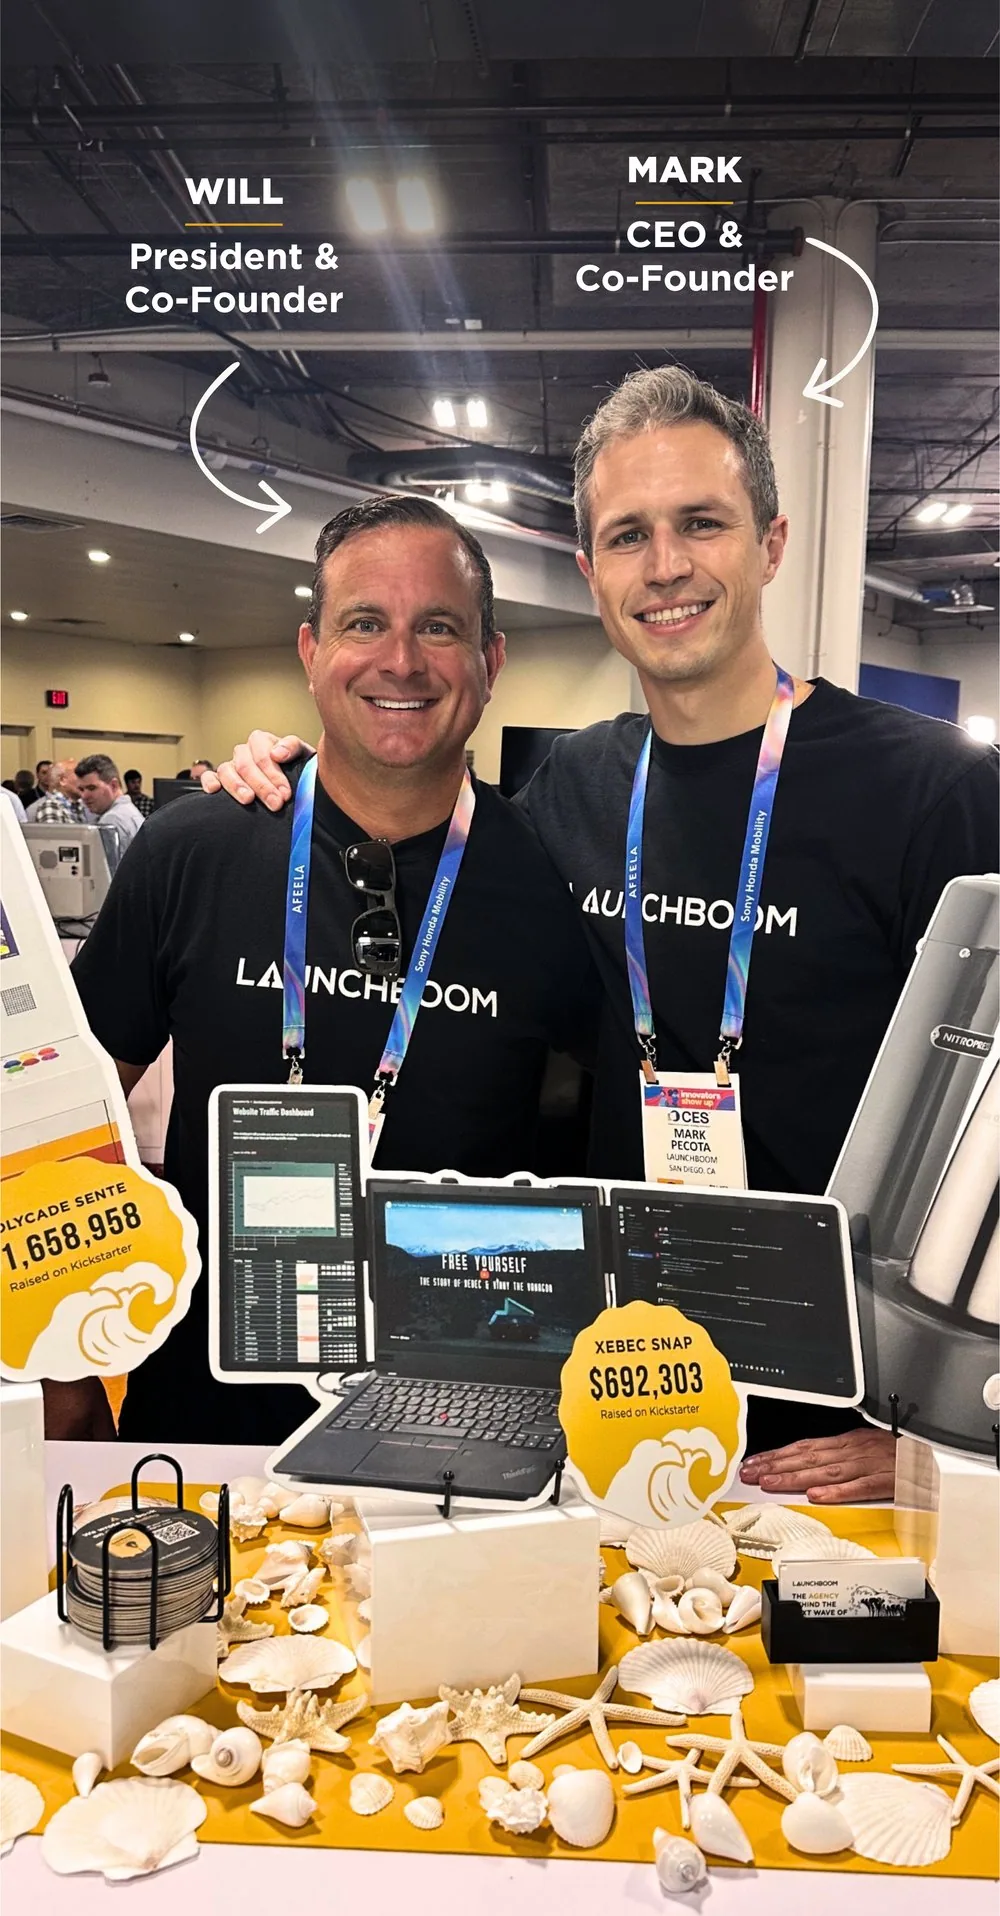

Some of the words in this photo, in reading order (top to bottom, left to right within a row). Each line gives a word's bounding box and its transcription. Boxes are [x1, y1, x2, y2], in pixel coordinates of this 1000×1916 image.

[751, 810, 768, 855] Mobility
[628, 846, 638, 899] AFEELA
[744, 857, 759, 892] Honda
[292, 864, 306, 914] AFEELA
[568, 882, 798, 937] AUCHBOM
[741, 896, 754, 922] Sony
[414, 947, 430, 973] Sony
[422, 916, 438, 947] Honda
[431, 876, 452, 915] Mobility
[680, 1090, 721, 1099] innovators
[681, 1111, 709, 1124] CES
[674, 1128, 706, 1140] MARK
[671, 1140, 711, 1152] PECOTA
[666, 1153, 718, 1164] LAUNCHBOOM
[669, 1164, 682, 1172] SAN
[706, 1167, 716, 1175] CA
[75, 1182, 127, 1208] SENTE
[9, 1272, 50, 1292] Raised
[52, 1266, 68, 1278] on
[70, 1244, 132, 1272] Kickstarter
[441, 1253, 468, 1271] FREE
[474, 1255, 527, 1274] YOURSELF
[419, 1276, 430, 1287] THE
[432, 1277, 451, 1288] STORY
[453, 1279, 461, 1288] OF
[513, 1281, 524, 1292] THE
[595, 1338, 646, 1354] XEBEC
[651, 1336, 693, 1351] SNAP
[589, 1361, 704, 1401] $692,303
[600, 1409, 633, 1419] Raised
[635, 1408, 647, 1417] on
[649, 1404, 700, 1416] Kickstarter
